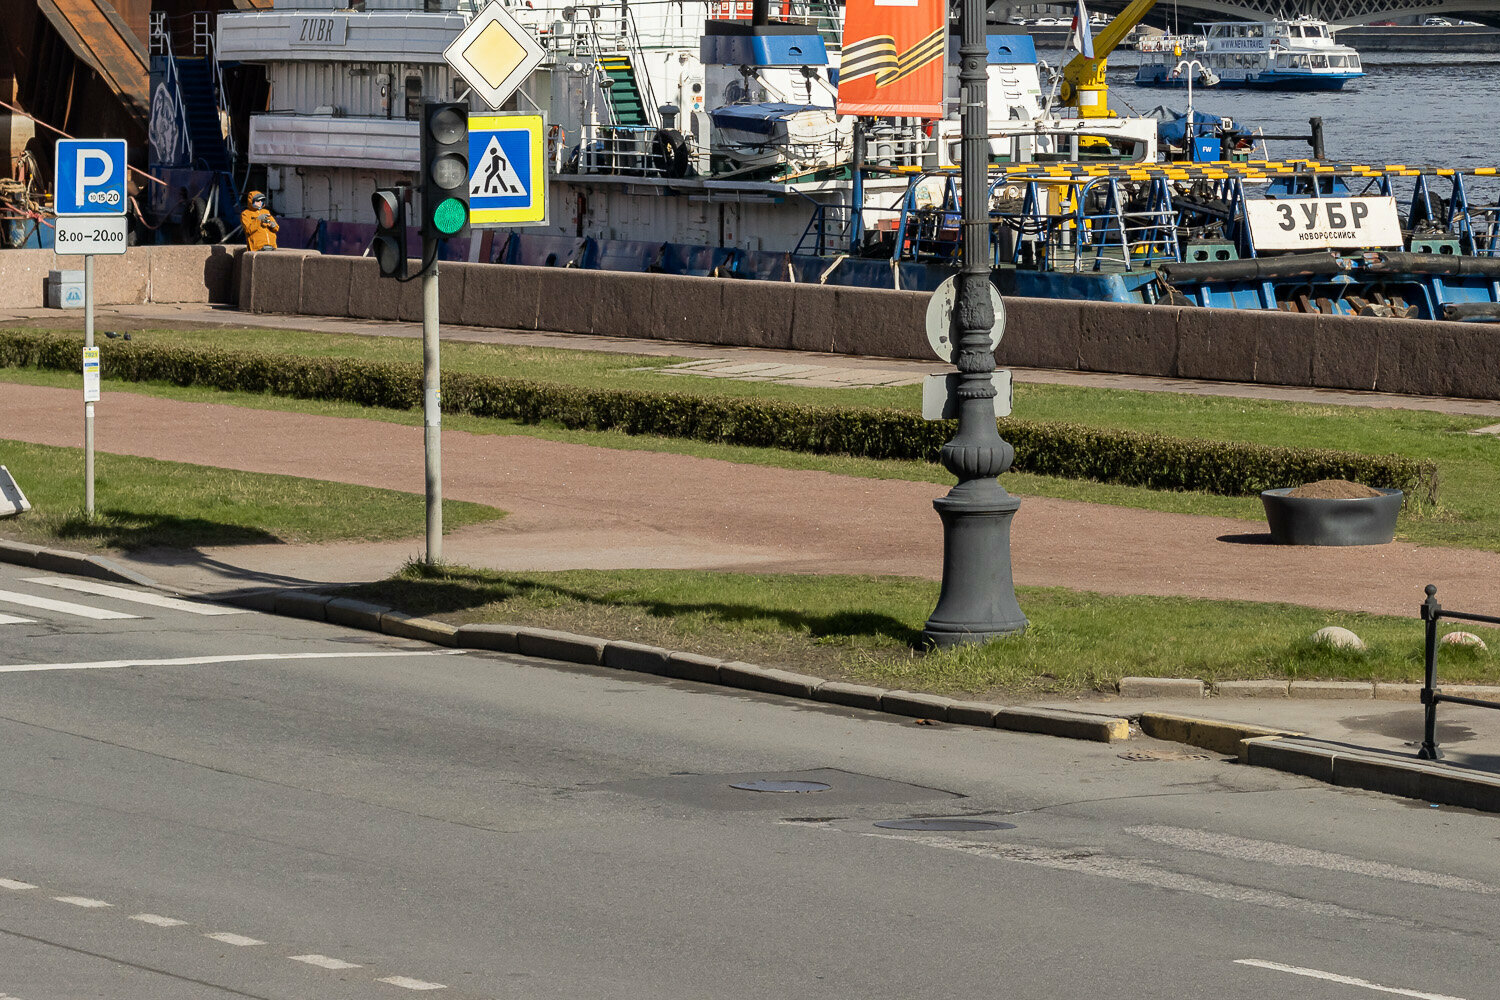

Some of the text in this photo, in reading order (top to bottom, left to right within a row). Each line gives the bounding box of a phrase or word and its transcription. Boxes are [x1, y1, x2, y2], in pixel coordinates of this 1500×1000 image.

[299, 18, 335, 42] ZUBR
[75, 148, 114, 206] P
[107, 193, 119, 202] 20
[1276, 201, 1369, 231] ЗУБР
[1298, 231, 1357, 241] НОВОРОССИЙСК
